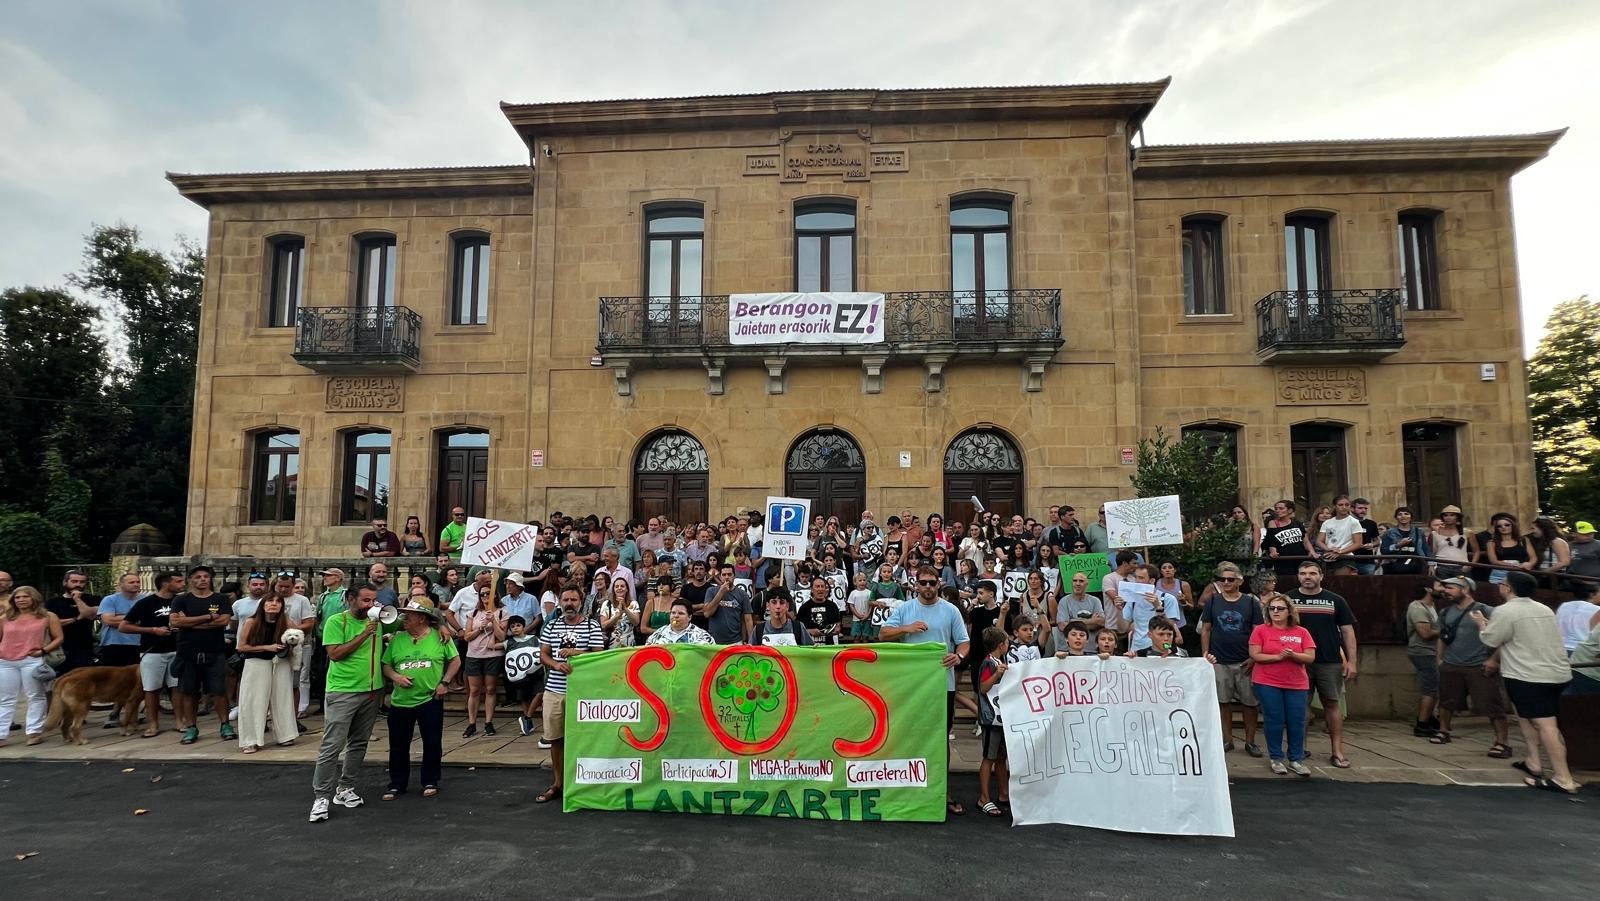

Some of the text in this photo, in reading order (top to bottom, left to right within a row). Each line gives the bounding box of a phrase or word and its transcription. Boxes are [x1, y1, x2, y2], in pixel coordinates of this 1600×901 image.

[807, 144, 843, 153] CASA
[750, 159, 776, 169] UDAL
[787, 157, 862, 168] CONSISTORIAL
[873, 155, 901, 165] ETXE
[735, 302, 832, 318] Berangon
[833, 303, 879, 334] EZ!
[735, 319, 831, 335] Jaietan erasorik
[1287, 369, 1357, 381] ESCUELA
[335, 378, 395, 389] ESCUELA
[466, 520, 500, 547] SOS
[478, 526, 536, 565] LANTZARTE
[1064, 557, 1107, 572] PARKING
[404, 661, 426, 669] SOS
[617, 645, 889, 758] SOS
[718, 705, 732, 716] 32
[1011, 707, 1203, 785] ILEGALA
[624, 787, 882, 822] LANTZARTE
